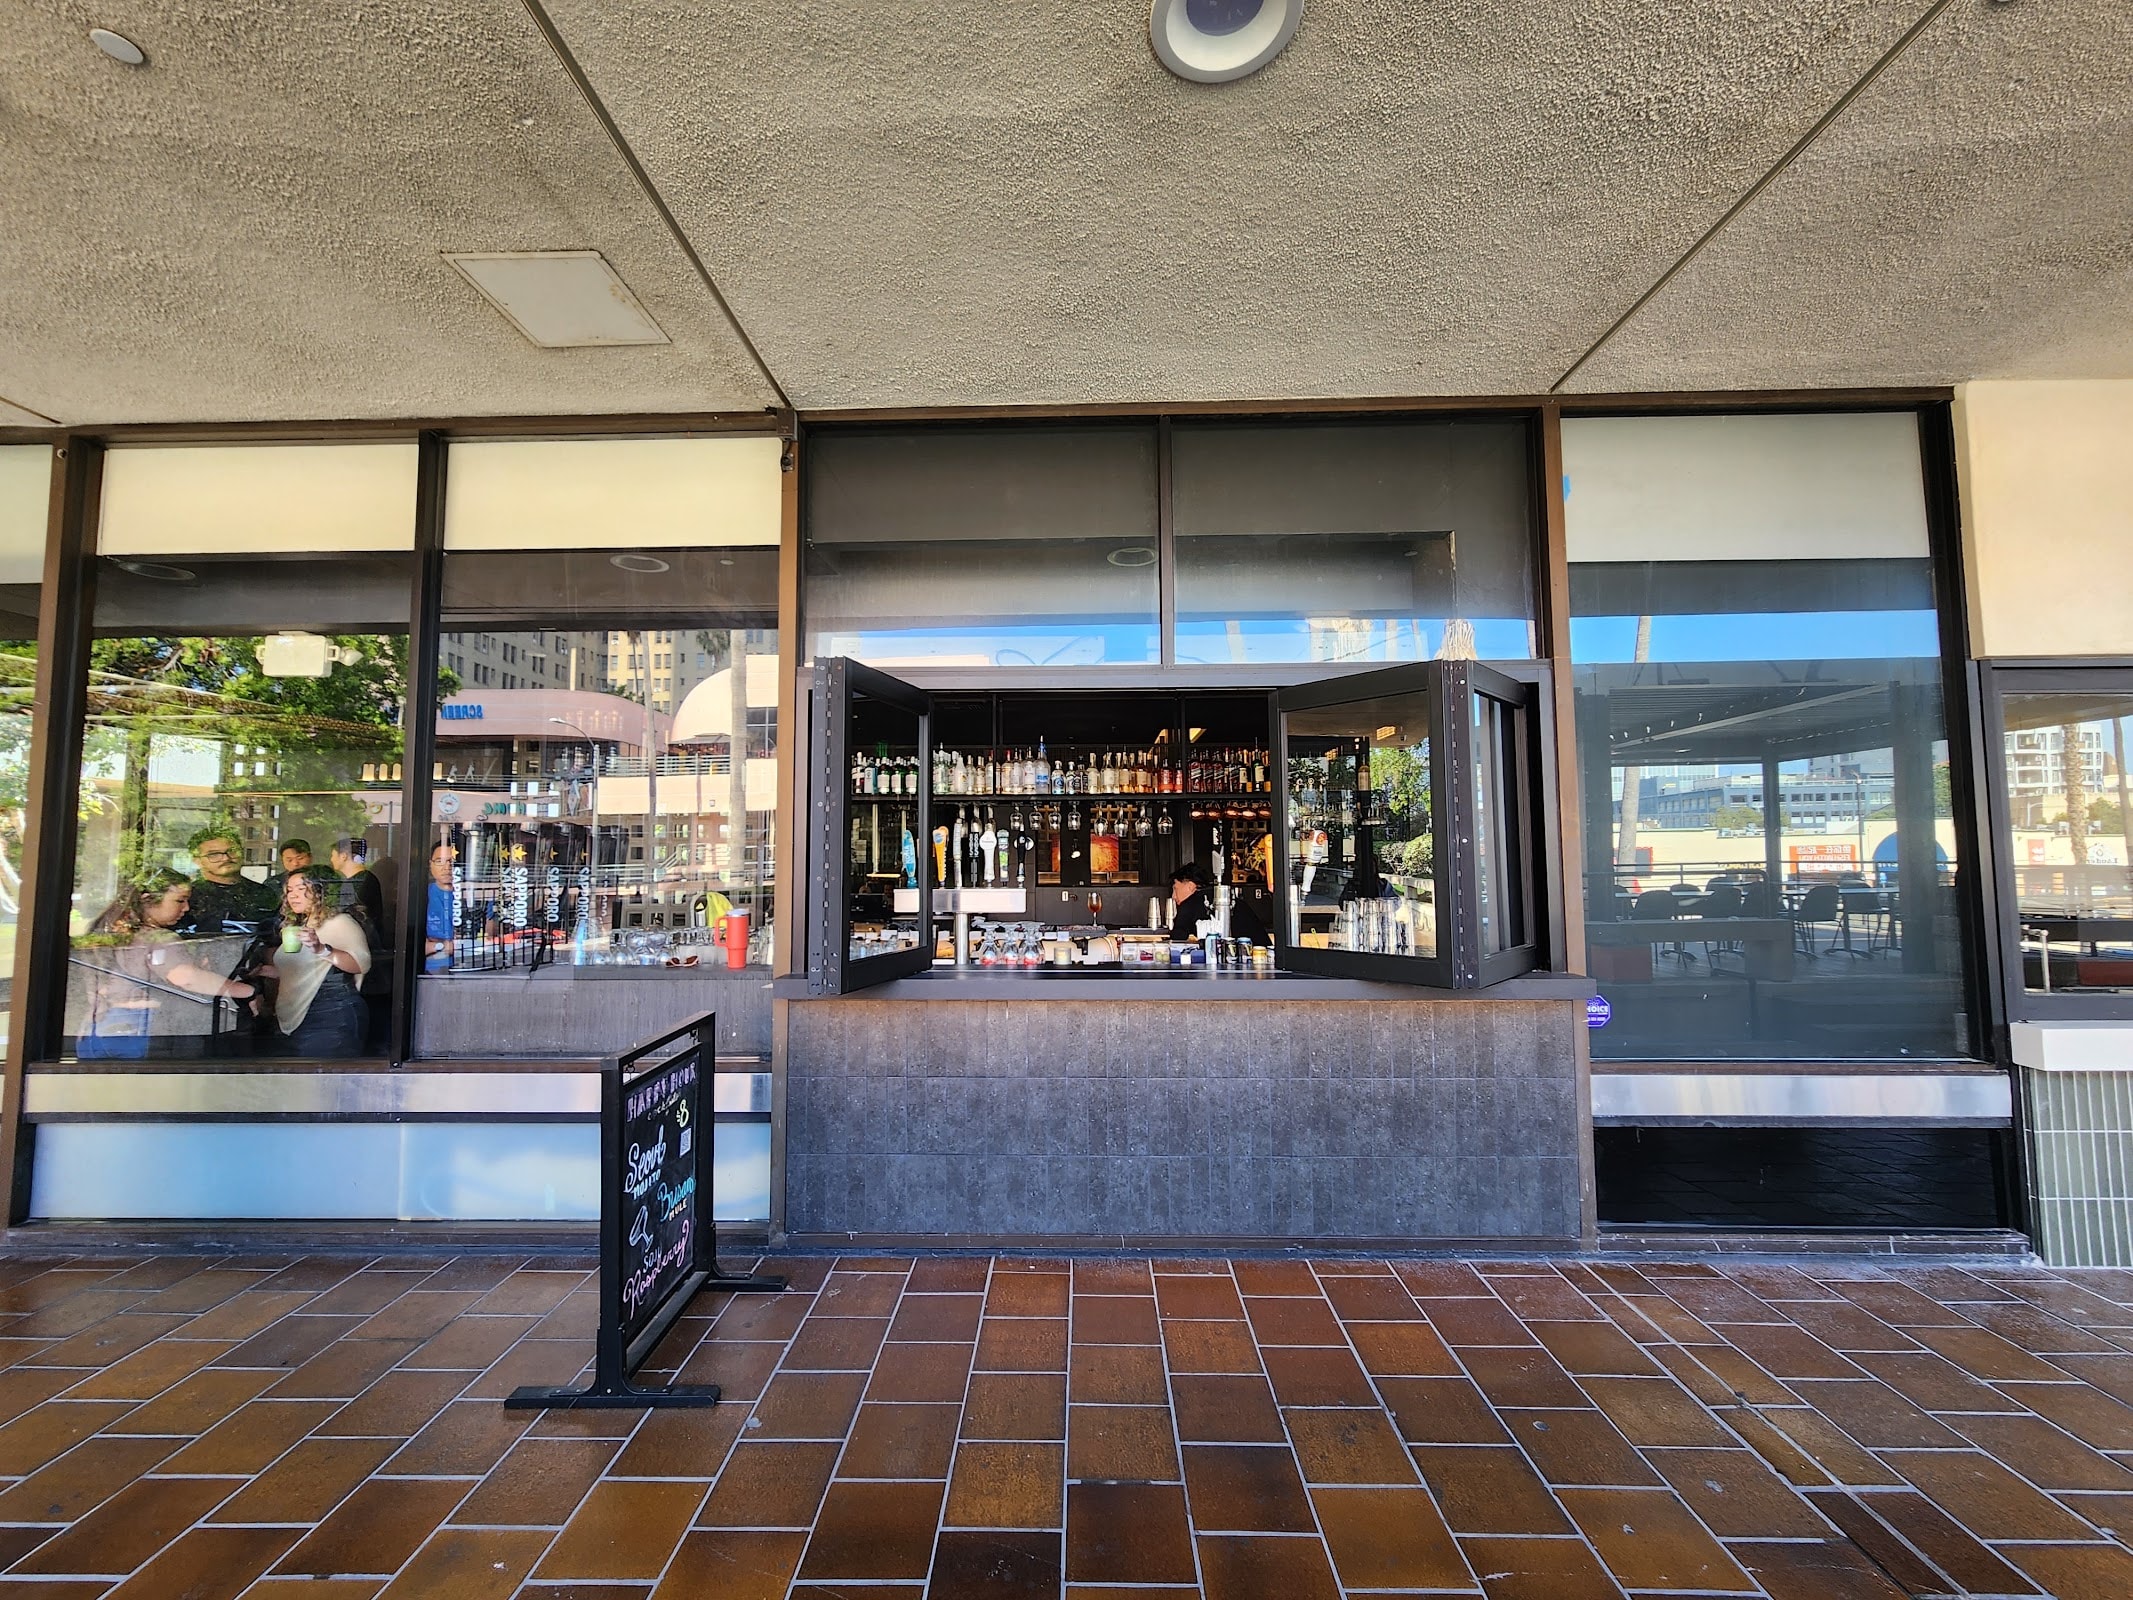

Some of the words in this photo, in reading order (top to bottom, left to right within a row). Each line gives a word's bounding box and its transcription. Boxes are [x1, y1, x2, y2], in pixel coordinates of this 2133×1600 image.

[452, 866, 463, 927] SAPPORO
[513, 867, 528, 927] SAPPORO
[547, 867, 560, 923] SAPPORO
[577, 867, 590, 919] SAPPORO
[1586, 1005, 1608, 1013] HOICE
[626, 1077, 667, 1123] HAPPY
[670, 1062, 696, 1094] HOUR
[633, 1168, 661, 1201] MOJITO
[668, 1198, 688, 1222] MULE
